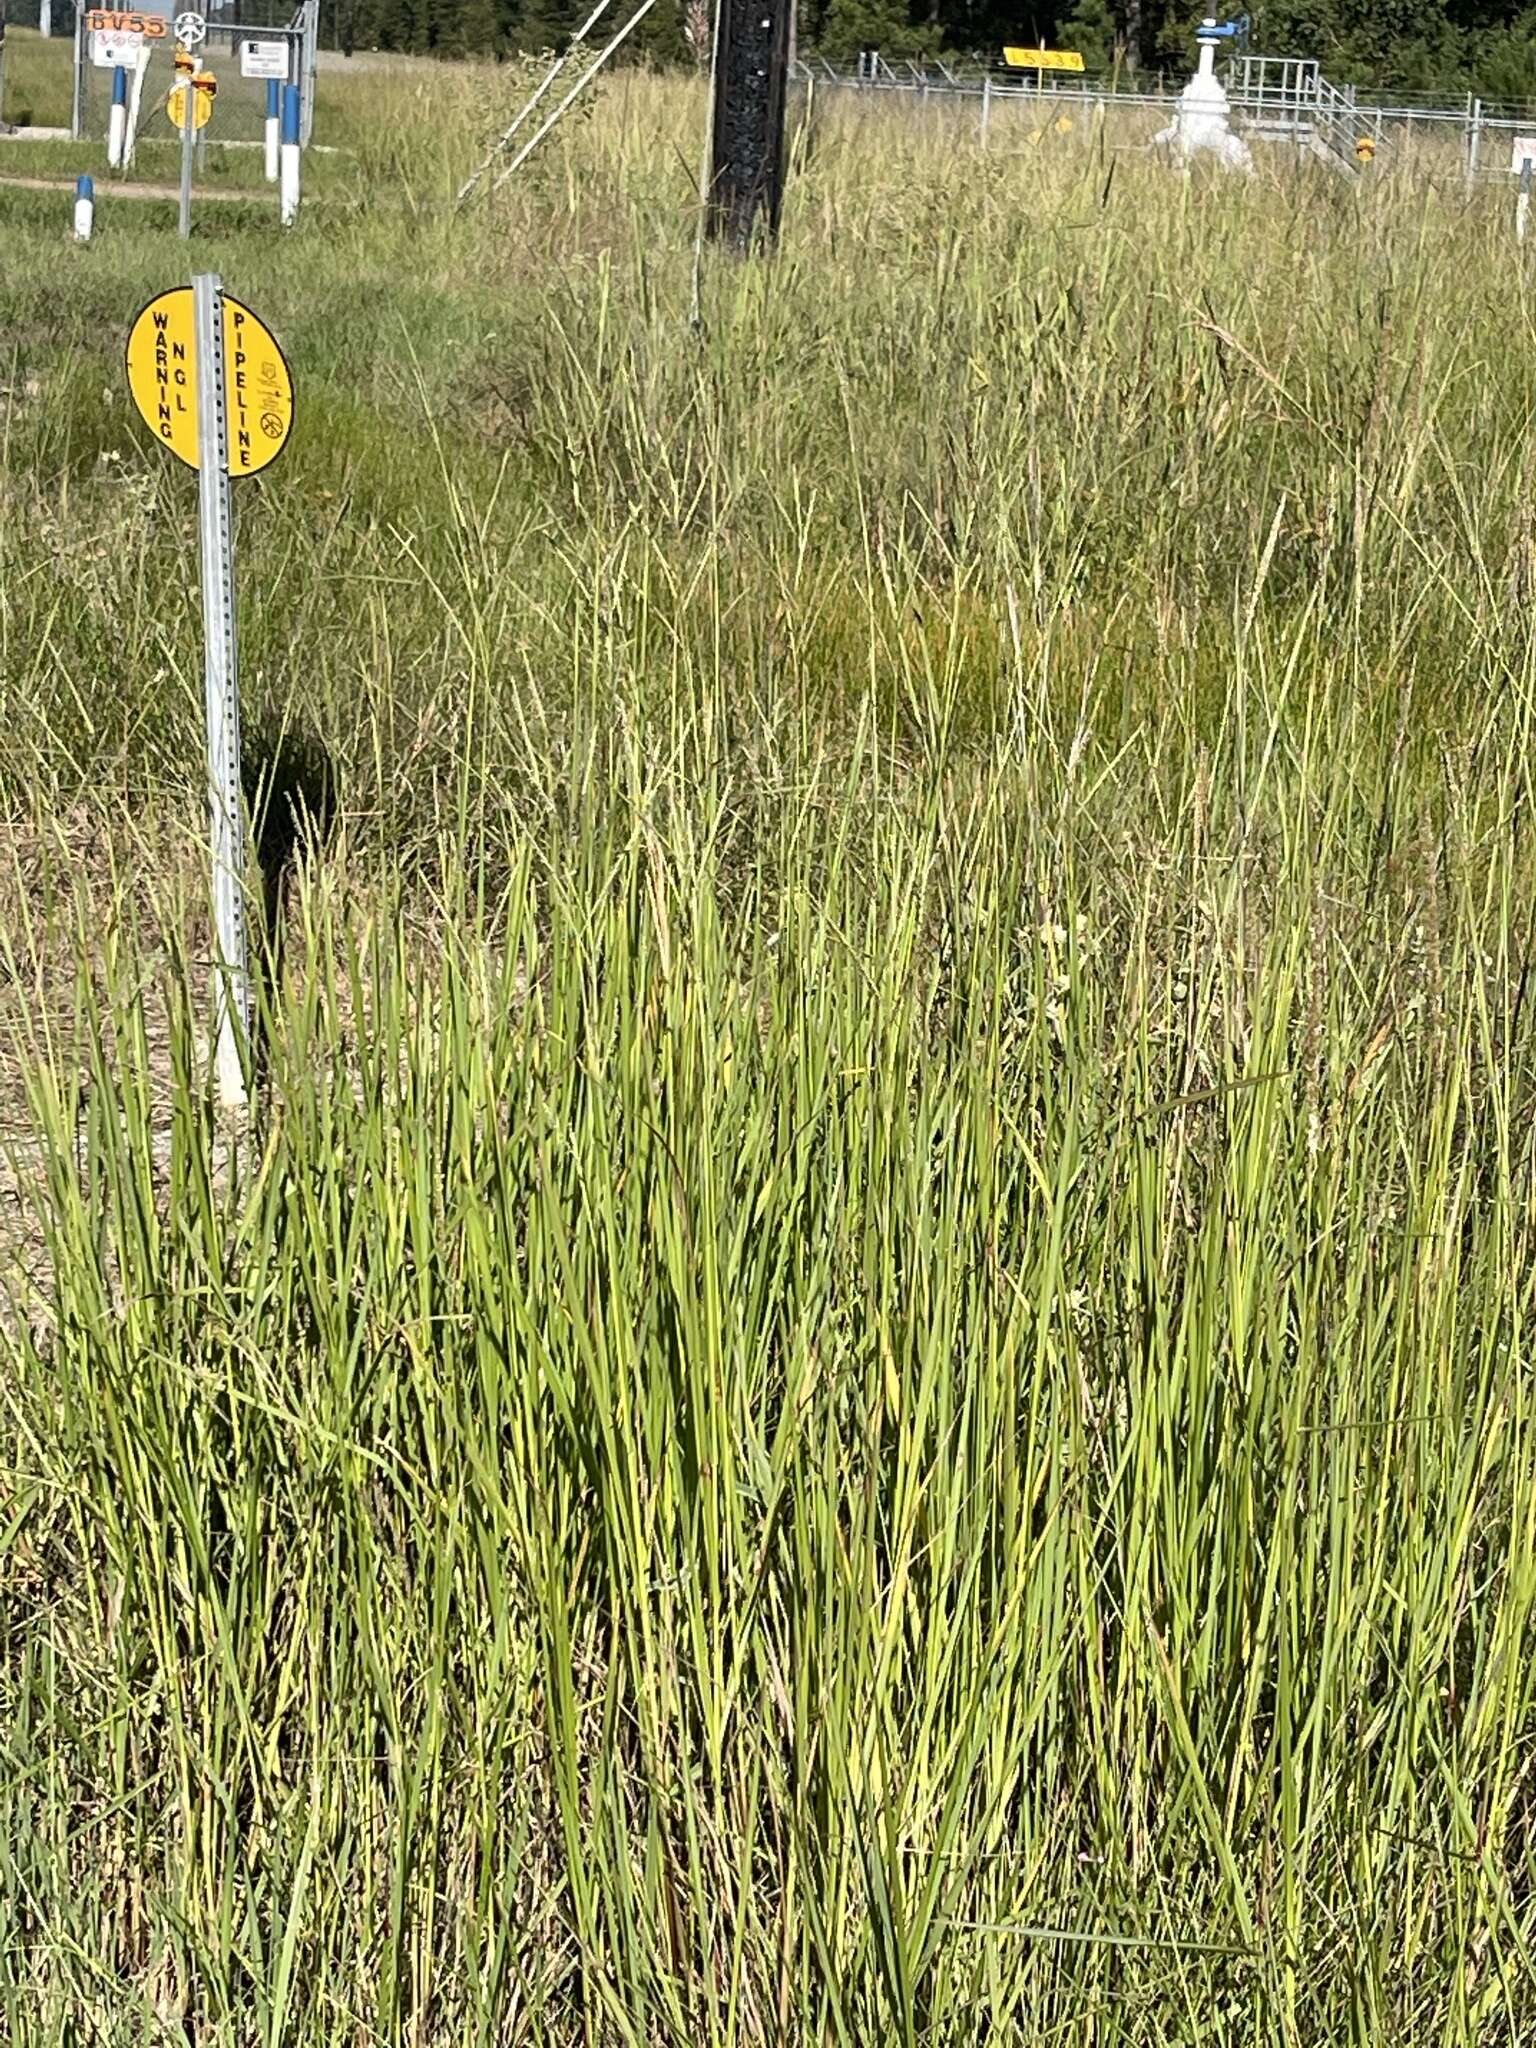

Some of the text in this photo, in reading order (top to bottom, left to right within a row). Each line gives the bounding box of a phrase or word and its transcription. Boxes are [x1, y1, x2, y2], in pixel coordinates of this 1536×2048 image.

[152, 311, 173, 440] WARNING
[173, 341, 187, 412] NGL
[234, 312, 250, 467] PIPELINE
